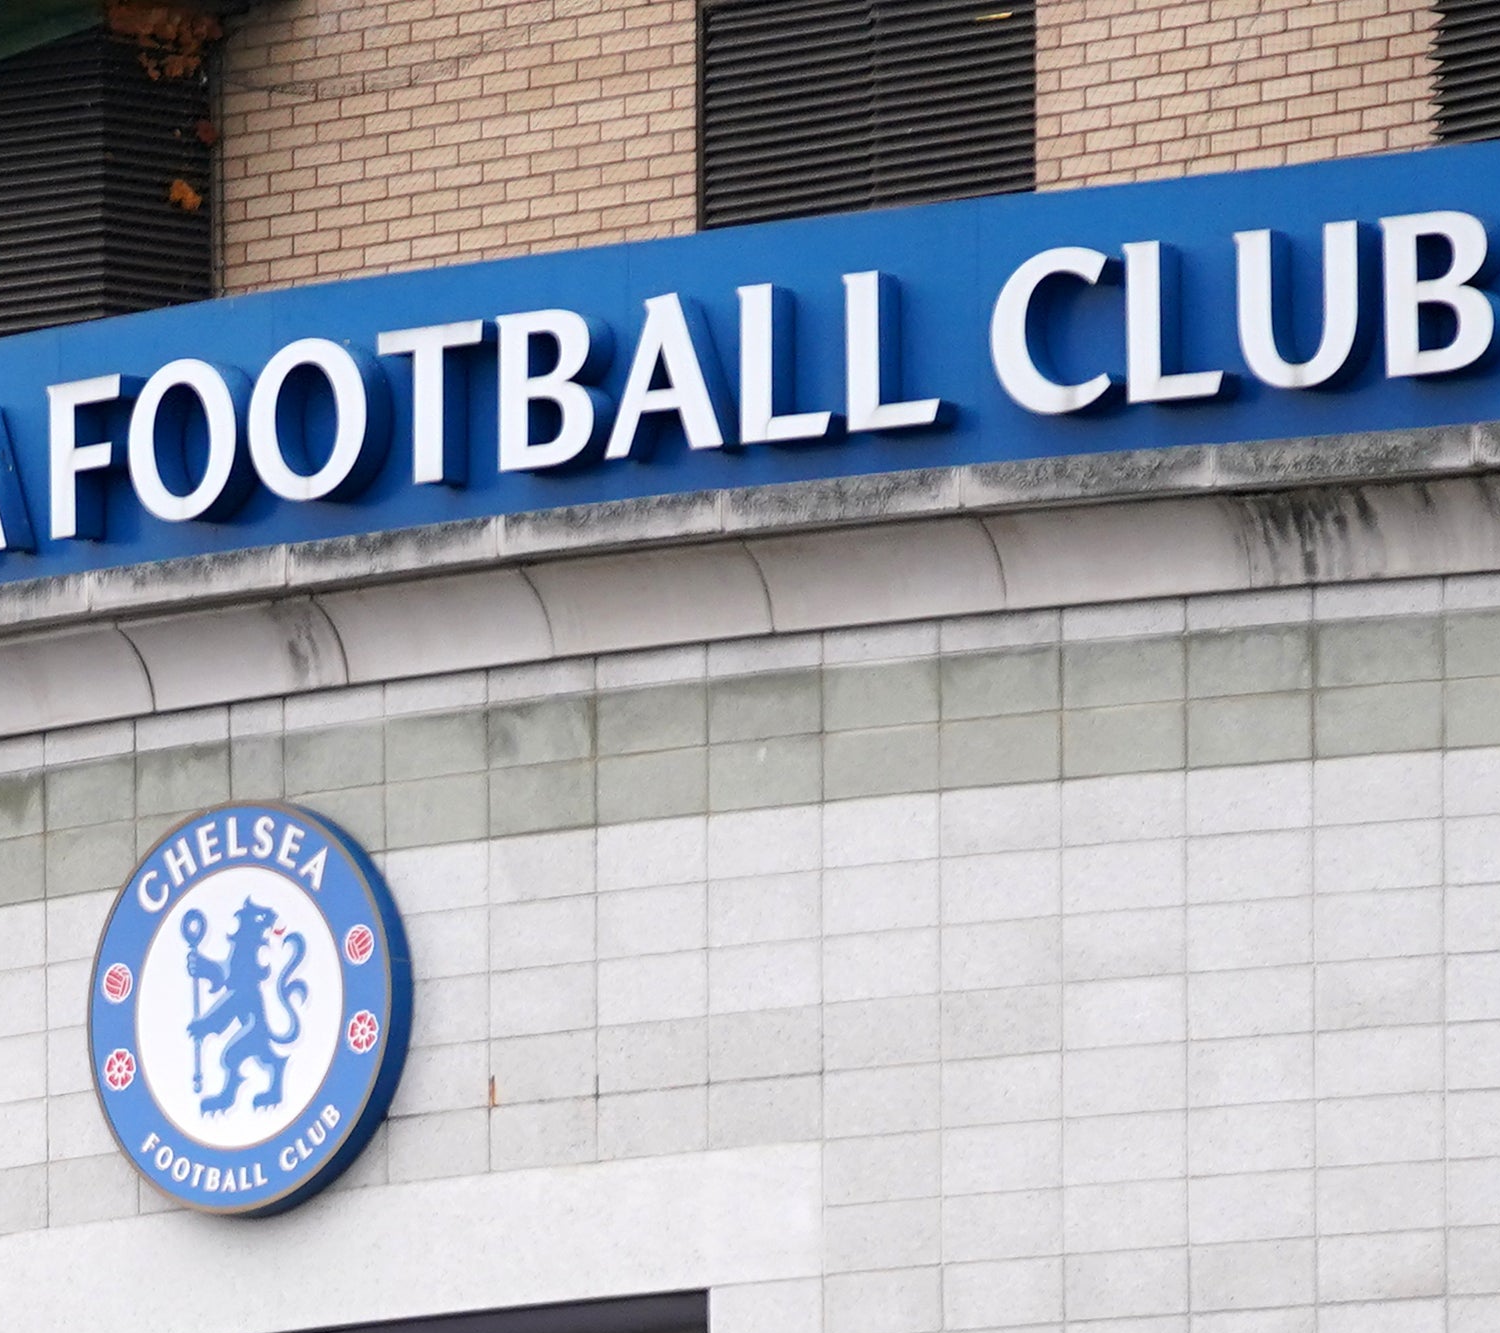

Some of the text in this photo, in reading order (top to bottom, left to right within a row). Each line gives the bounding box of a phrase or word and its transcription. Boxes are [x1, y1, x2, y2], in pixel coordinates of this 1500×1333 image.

[47, 270, 942, 542] FOOTBALL
[988, 208, 1498, 418] CLUB
[138, 815, 329, 913] CHELSEA
[141, 1104, 341, 1193] FOOTBALL CLUB
